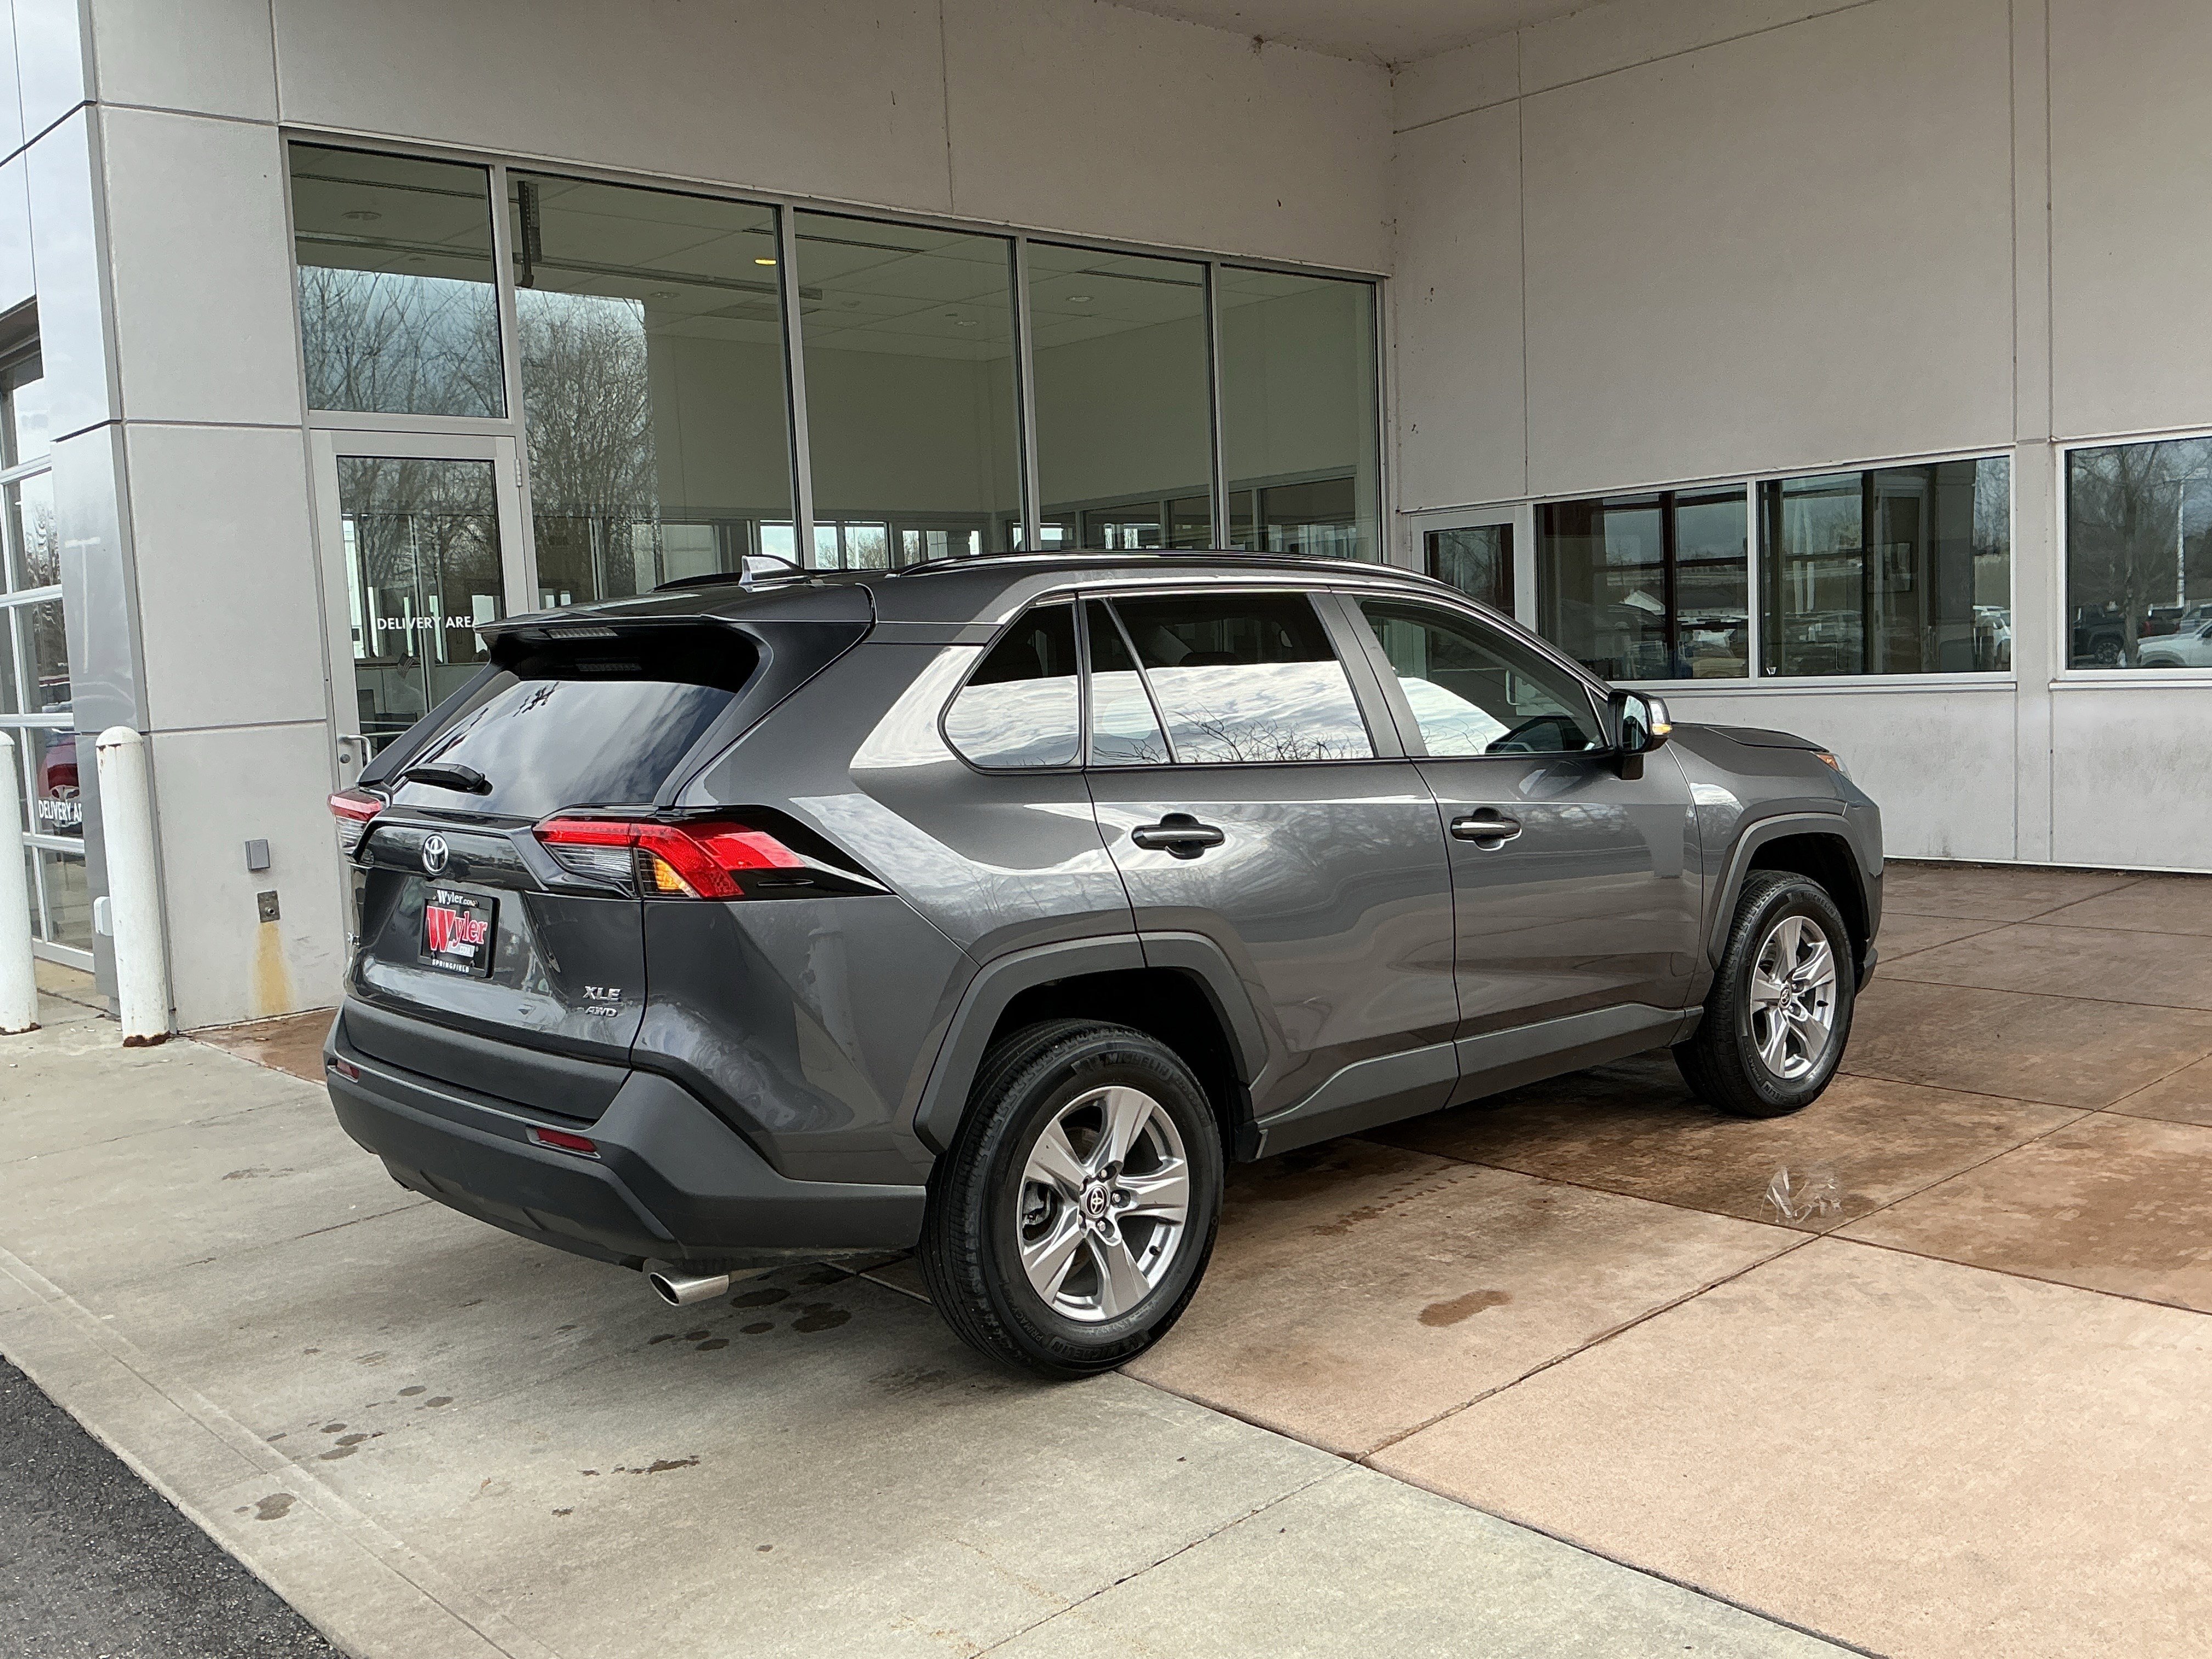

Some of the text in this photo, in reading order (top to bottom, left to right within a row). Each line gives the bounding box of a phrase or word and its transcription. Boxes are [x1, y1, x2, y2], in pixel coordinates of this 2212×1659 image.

[377, 616, 442, 630] DELIVERY
[38, 799, 71, 821] DELIVERY
[427, 906, 488, 952] Wyler
[432, 959, 470, 973] SPRINGFIELD
[583, 986, 622, 1001] XLE
[584, 1006, 618, 1017] AWD
[1105, 1052, 1170, 1076] MICHELIN
[1011, 1307, 1043, 1342] PRIMACY
